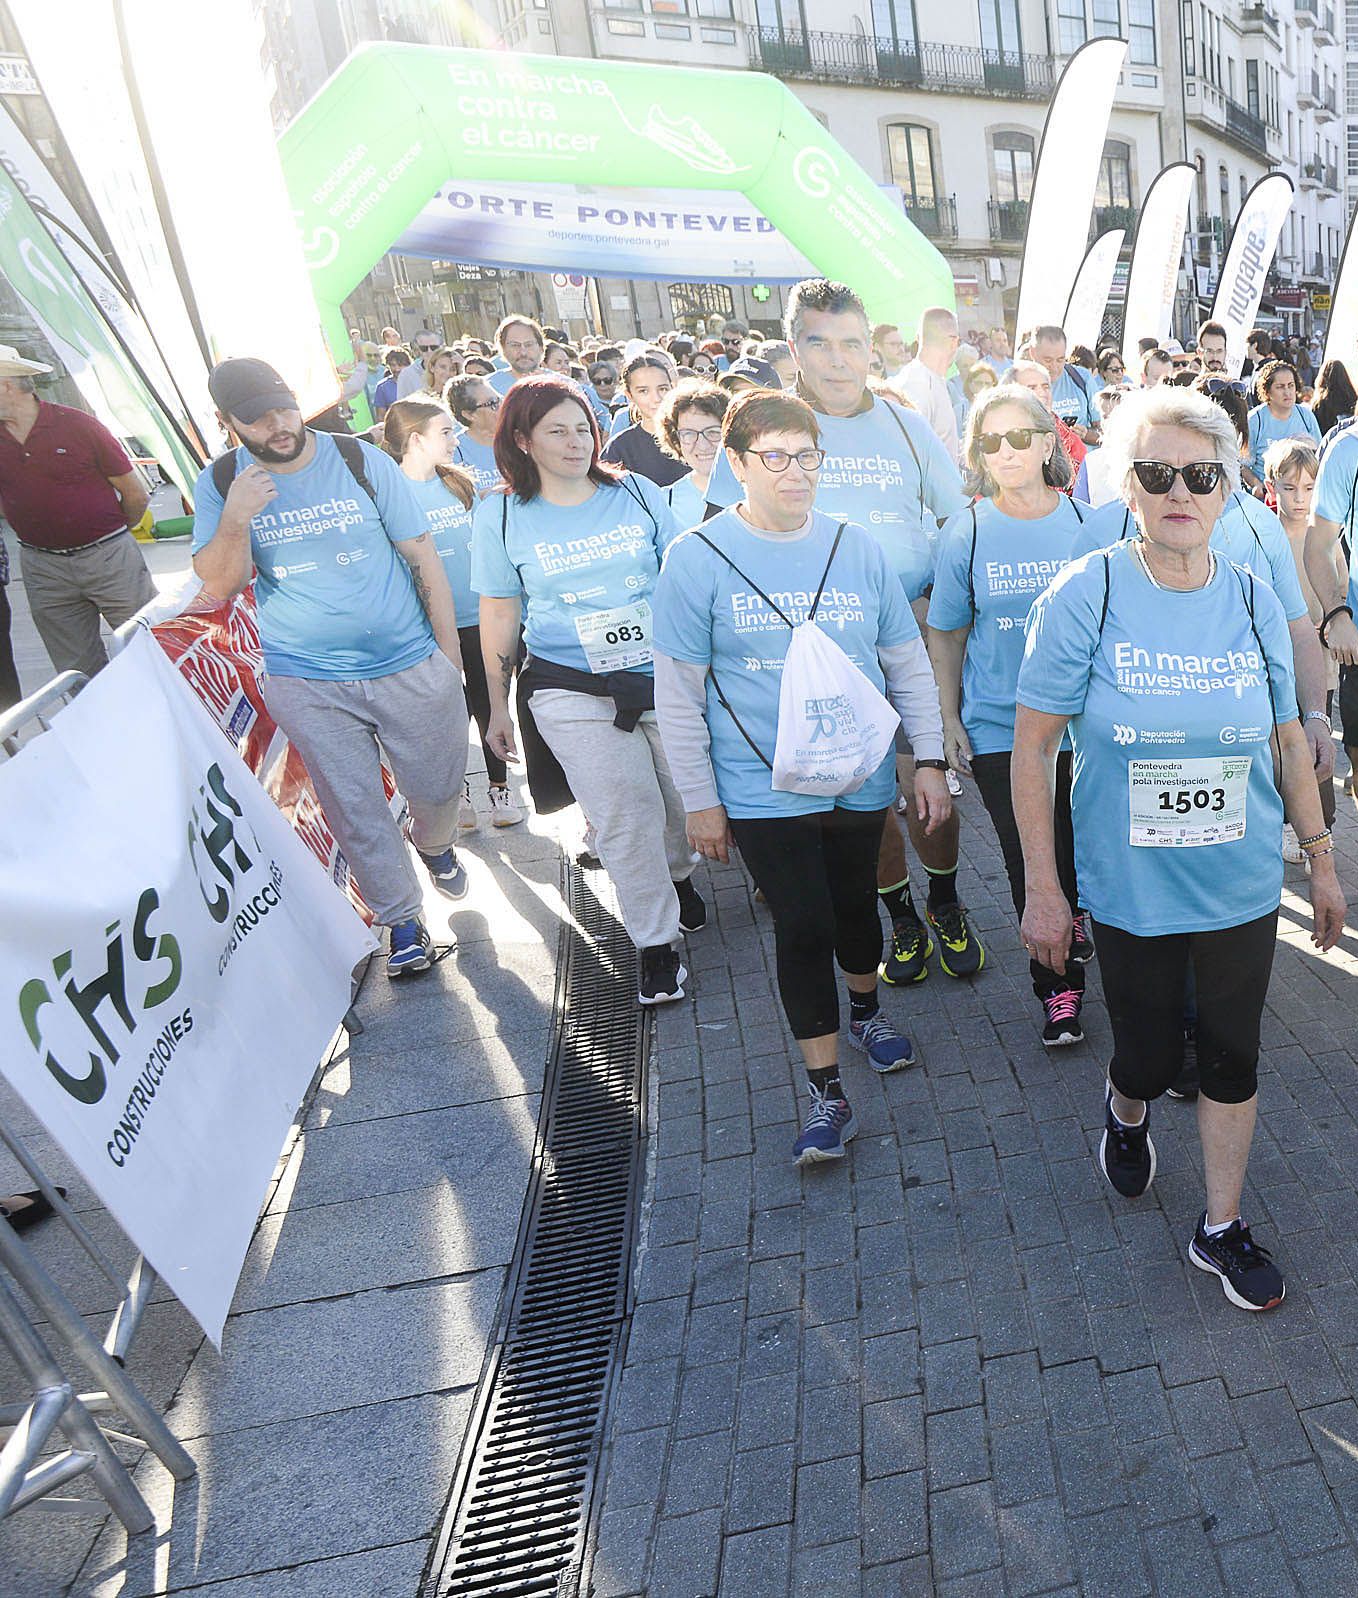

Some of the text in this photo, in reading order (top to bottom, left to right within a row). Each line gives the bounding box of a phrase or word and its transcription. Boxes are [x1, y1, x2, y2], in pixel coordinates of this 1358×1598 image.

[447, 63, 609, 97] En marcha
[457, 95, 558, 121] contra
[462, 122, 601, 152] el cáncer
[434, 190, 554, 220] ORTE
[548, 229, 670, 248] deportes.pontevedra.gal
[457, 263, 480, 273] Viajes
[459, 271, 482, 280] Deza
[1227, 230, 1266, 326] nugape
[823, 454, 902, 473] marcha
[251, 497, 360, 530] En marcha
[534, 522, 646, 560] En marcha
[985, 561, 1013, 578] En
[731, 587, 862, 612] En marcha
[605, 625, 644, 645] 083
[1114, 642, 1260, 674] En marcha
[1117, 685, 1143, 695] contra
[1151, 687, 1181, 697] cancro
[1126, 668, 1261, 694] investigación
[1140, 728, 1186, 738] Deputación
[1140, 736, 1186, 744] Pontevedra
[1132, 762, 1183, 770] Pontevedra
[1145, 770, 1178, 778] marcha
[1132, 777, 1209, 787] pola investigación
[1158, 788, 1225, 814] 1503
[19, 887, 183, 1105] CHS
[107, 1007, 194, 1168] CONSTRUCCIONES
